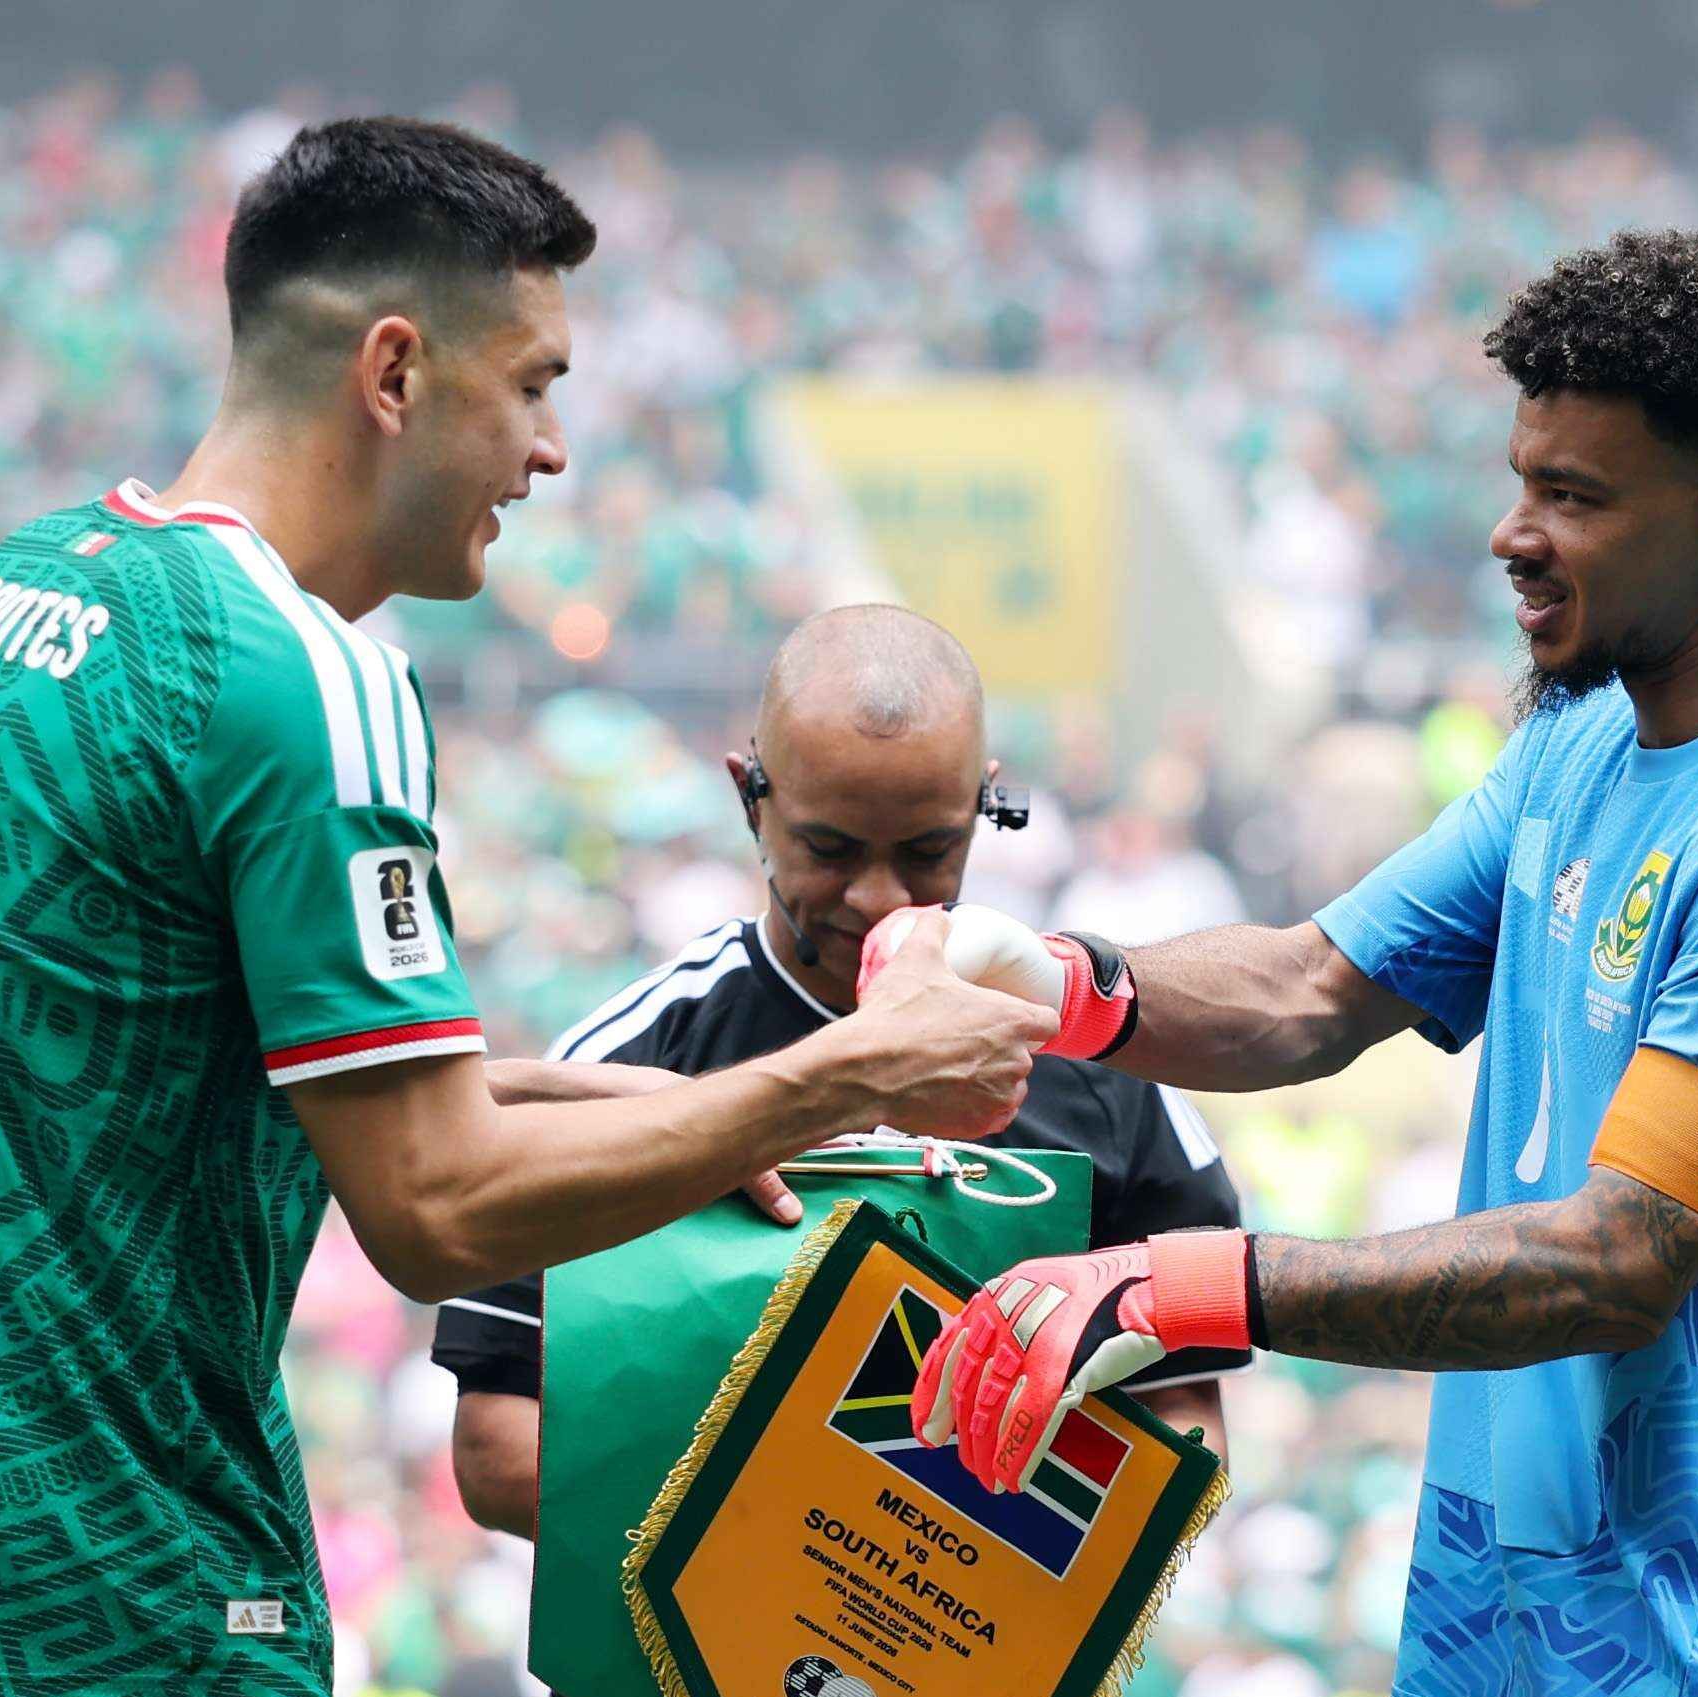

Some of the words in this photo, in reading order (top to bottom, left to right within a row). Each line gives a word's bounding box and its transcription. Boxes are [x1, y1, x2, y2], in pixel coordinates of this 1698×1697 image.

[875, 1487, 979, 1567] MEXICO
[903, 1538, 930, 1565] VS
[802, 1544, 847, 1578] SENIOR
[846, 1571, 884, 1600] MEN'S
[882, 1593, 937, 1637] NATIONAL
[939, 1631, 972, 1659] TEAM
[804, 1507, 900, 1578] SOUTH
[898, 1570, 997, 1646] AFRICA
[824, 1577, 848, 1599] FIFA
[848, 1591, 887, 1621] WORLD
[886, 1616, 910, 1635] CUP
[908, 1631, 933, 1652] 2026
[794, 1613, 828, 1638] ESTADIO
[867, 1659, 898, 1683] MEXICO
[897, 1678, 916, 1694] CITY
[835, 1613, 849, 1625] 11
[848, 1621, 876, 1643] JUNE
[874, 1637, 899, 1658] 2026
